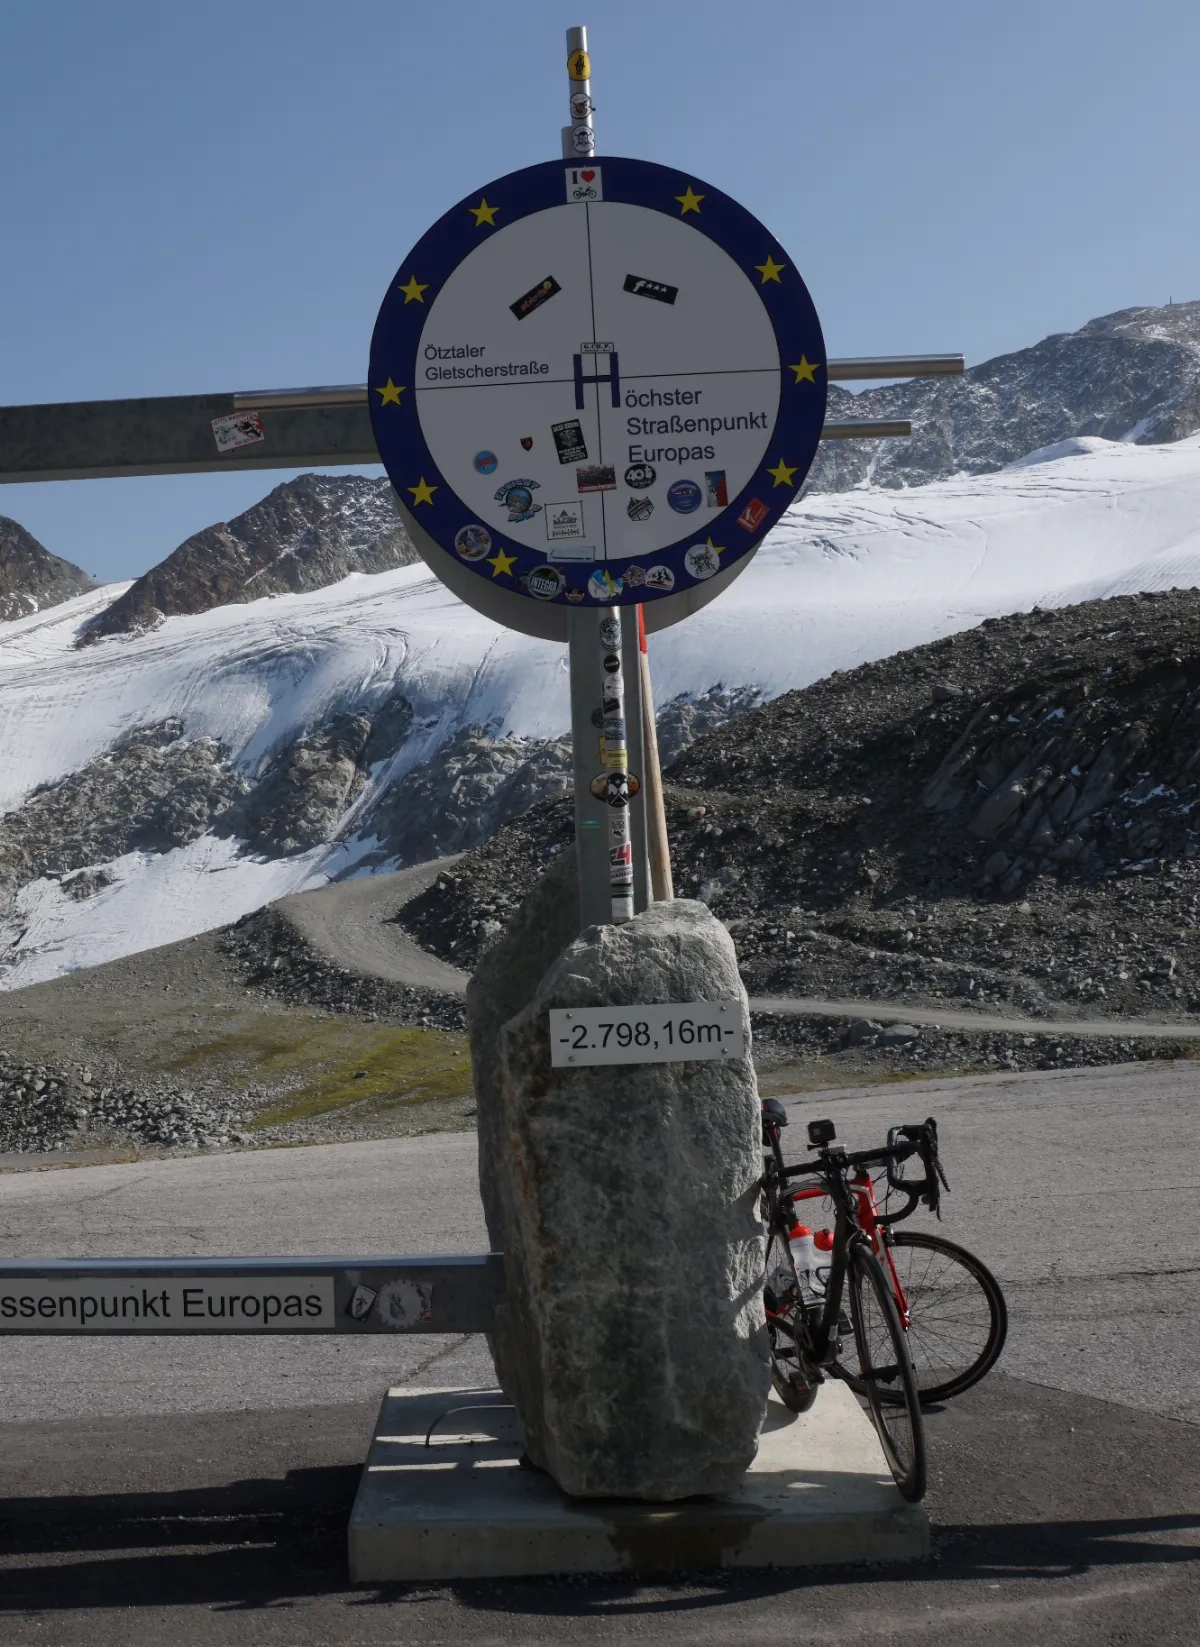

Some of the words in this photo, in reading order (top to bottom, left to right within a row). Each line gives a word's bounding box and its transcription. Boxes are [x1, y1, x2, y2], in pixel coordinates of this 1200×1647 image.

[424, 344, 486, 361] Ötztaler
[425, 361, 550, 381] Gletscherstraße
[627, 412, 768, 436] Straßenpunkt
[629, 445, 715, 465] Europas
[182, 1289, 323, 1325] Europas
